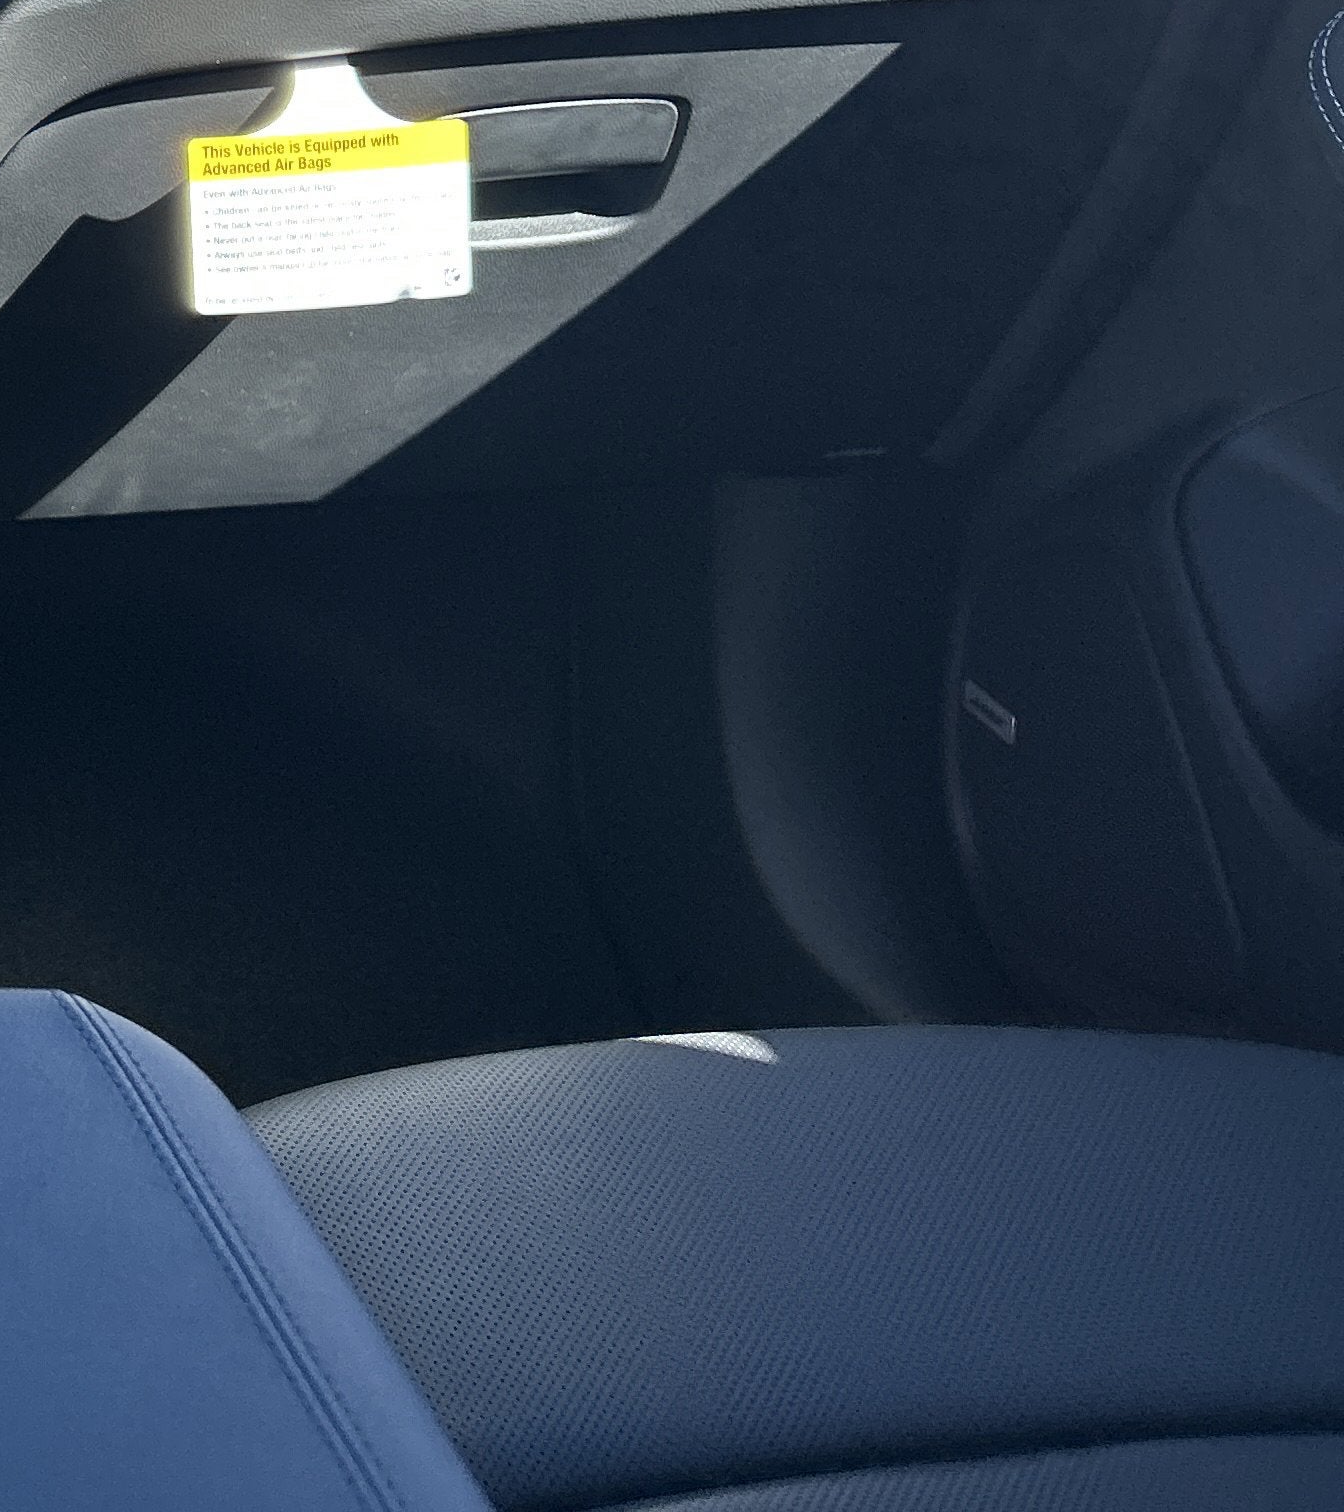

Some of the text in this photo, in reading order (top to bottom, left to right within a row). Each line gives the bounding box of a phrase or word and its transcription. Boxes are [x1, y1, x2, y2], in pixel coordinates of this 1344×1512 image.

[202, 133, 399, 159] This Vehicle is Equipped with
[203, 156, 332, 176] Advanced Air Bags
[203, 190, 226, 199] Even
